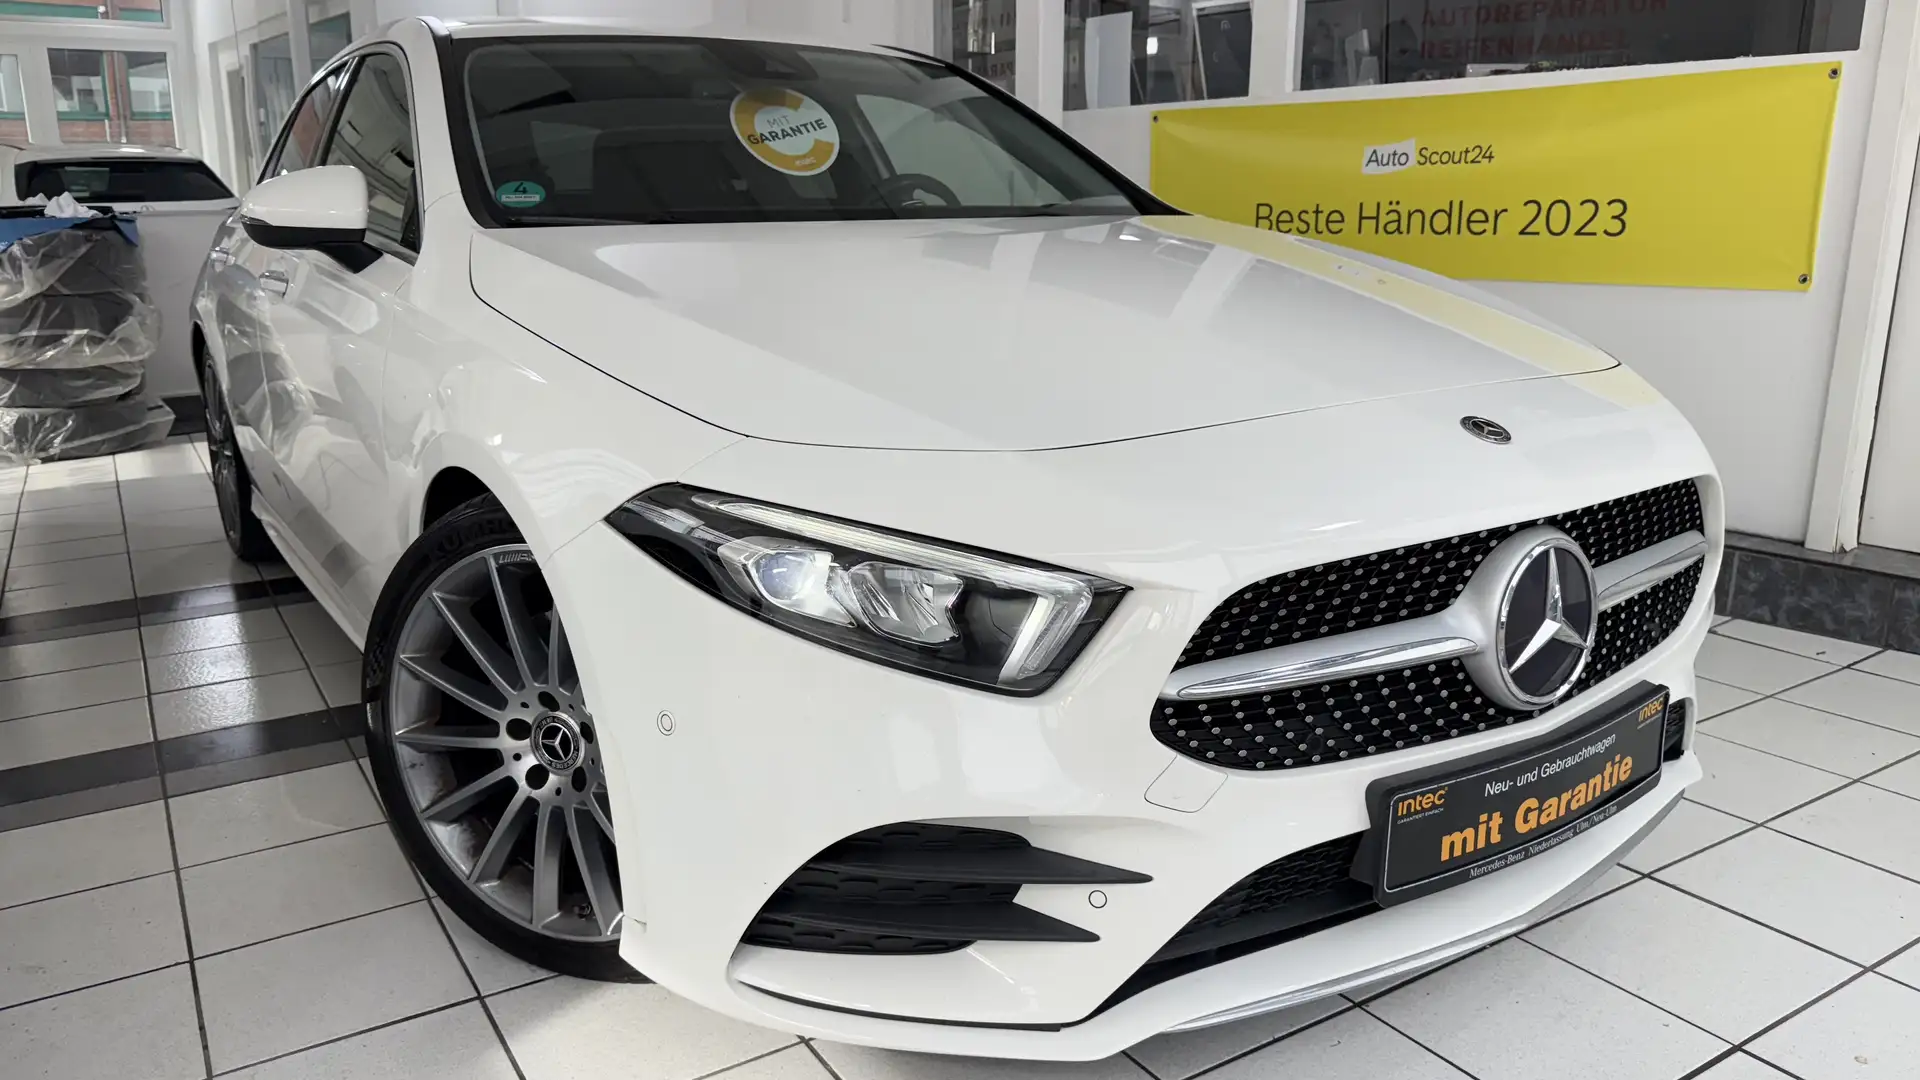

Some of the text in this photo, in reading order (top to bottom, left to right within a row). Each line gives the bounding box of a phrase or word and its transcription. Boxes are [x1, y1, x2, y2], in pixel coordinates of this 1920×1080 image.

[747, 118, 828, 145] GARANTIE
[766, 115, 791, 129] MIT
[1365, 144, 1495, 167] Auto Scout24
[514, 182, 527, 194] 4
[1255, 198, 1628, 237] Beste Händler 2023
[1484, 733, 1616, 797] Neu- und Gebrauchtwagen
[1397, 789, 1446, 816] intec
[1440, 753, 1633, 862] mit Garantie
[1468, 851, 1526, 879] Mercedes-Benz
[1528, 829, 1575, 857] Niederlassung
